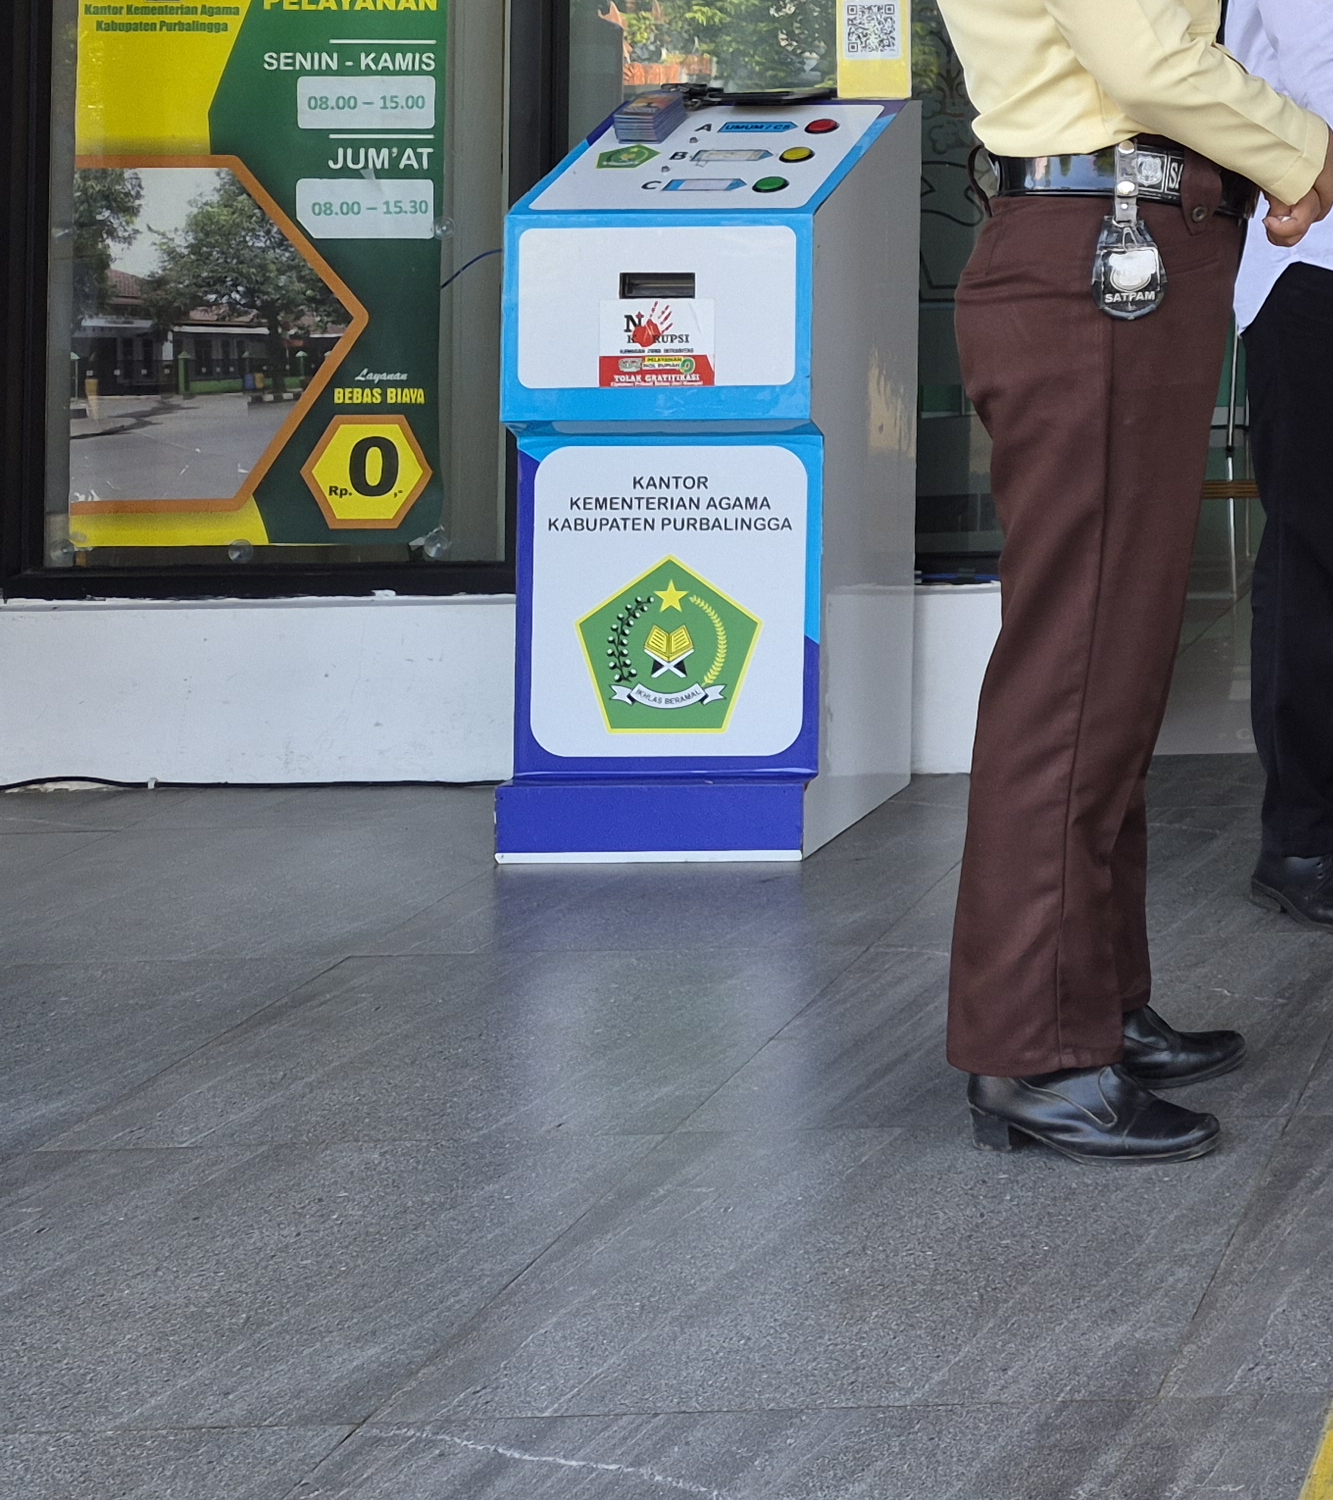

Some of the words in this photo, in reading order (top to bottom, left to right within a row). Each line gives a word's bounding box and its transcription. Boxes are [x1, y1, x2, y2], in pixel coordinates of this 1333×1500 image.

[84, 3, 125, 17] Kantor
[126, 3, 198, 17] Kementerian
[199, 3, 241, 18] Agama
[95, 19, 158, 34] Kabupaten
[158, 19, 229, 34] Purbalingga
[263, 51, 339, 72] SENIN
[360, 51, 437, 72] KAMIS
[306, 94, 358, 112] 08.00
[379, 93, 426, 111] 15.00
[310, 200, 362, 217] 08.00
[381, 198, 430, 216] 15.30
[1104, 290, 1156, 303] SATPAM
[353, 367, 408, 382] Layanan
[333, 387, 382, 405] BEBAS
[386, 387, 426, 405] BIAYA
[632, 474, 710, 491] KANTOR
[569, 495, 701, 512] KEMENTERIAN
[705, 495, 772, 512] AGAMA
[547, 516, 656, 532] KABUPATEN
[660, 516, 794, 532] PURBALINGGA
[635, 688, 663, 706] IKHLAS
